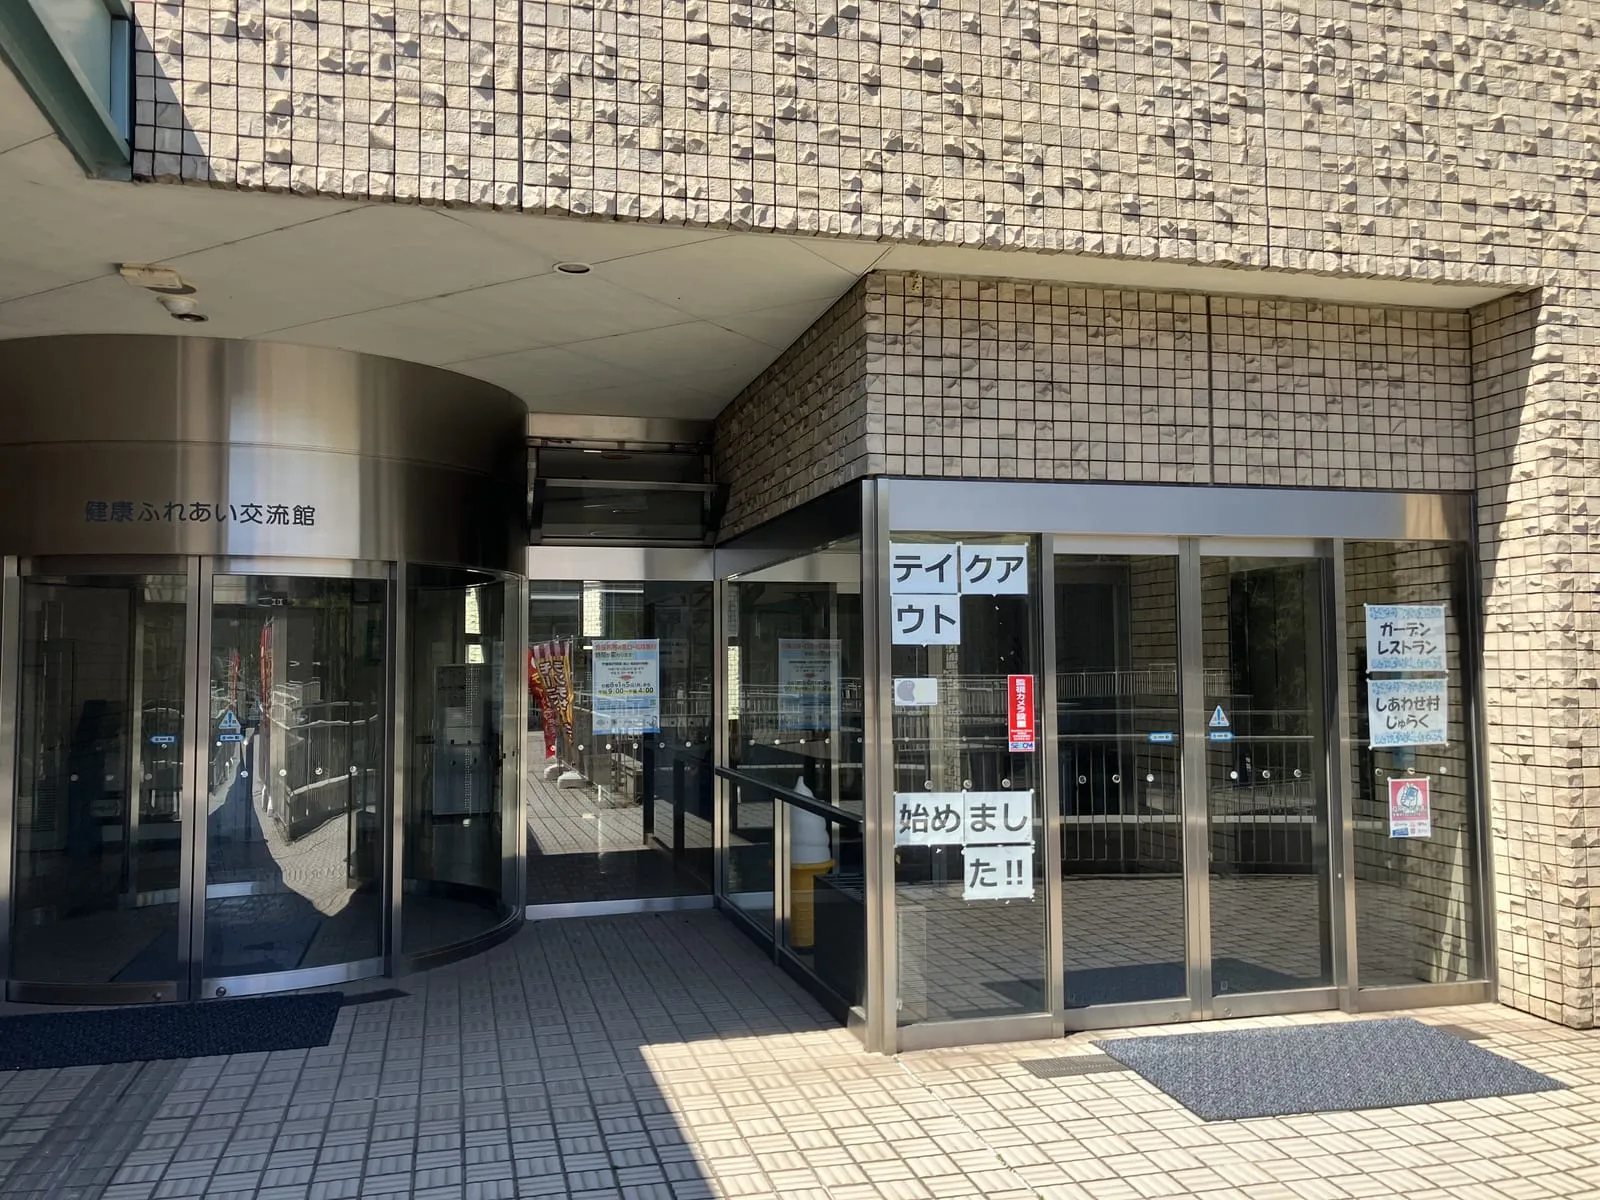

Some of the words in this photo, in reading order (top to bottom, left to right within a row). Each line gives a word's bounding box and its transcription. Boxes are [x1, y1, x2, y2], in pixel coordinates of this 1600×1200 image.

[84, 500, 317, 527] 健康ふれあい交流館
[897, 604, 957, 634] ウト
[1380, 621, 1431, 637] ガーデン
[1377, 640, 1438, 656] レストラン
[1375, 695, 1441, 712] しあわせ村
[1386, 714, 1430, 730] じゅらく
[899, 803, 1028, 834] 始めまし
